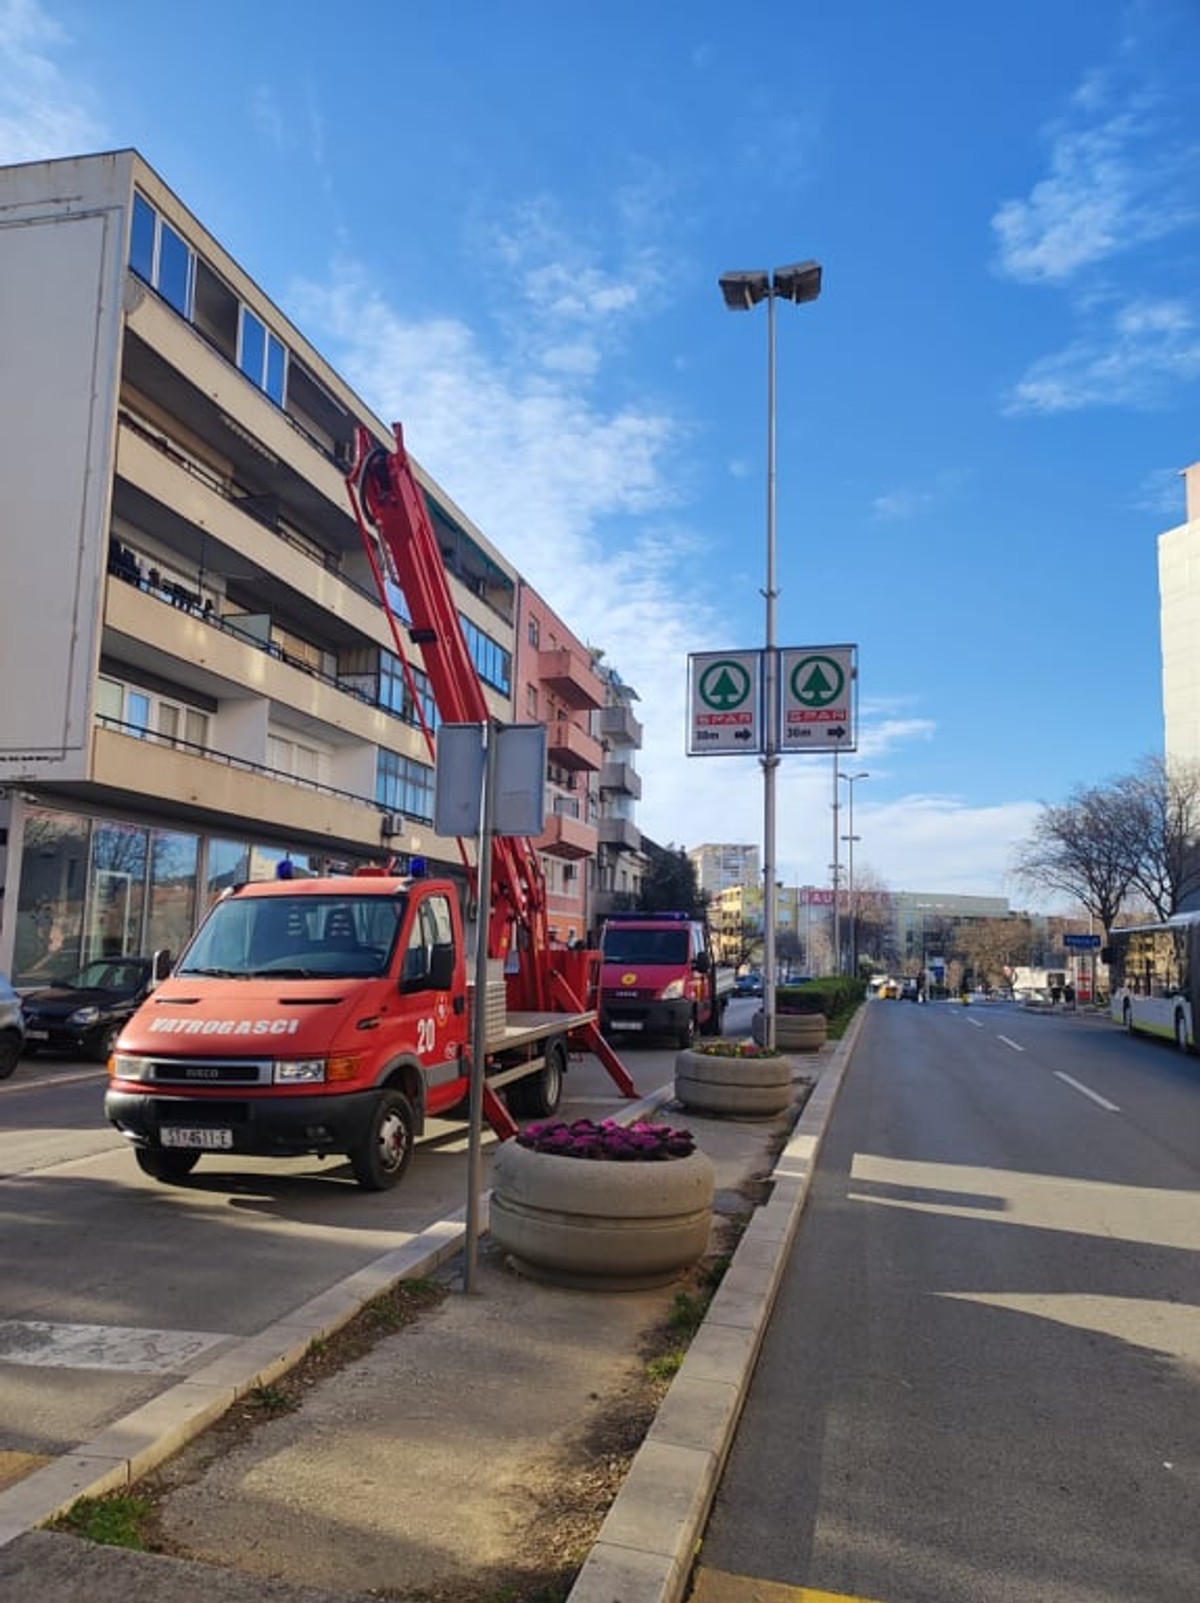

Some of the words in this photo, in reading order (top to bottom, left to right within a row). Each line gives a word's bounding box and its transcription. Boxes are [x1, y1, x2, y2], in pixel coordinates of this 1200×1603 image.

[697, 712, 752, 725] SPAR
[788, 710, 846, 722] SPAR
[150, 1018, 299, 1035] VATROGASCI
[417, 1018, 435, 1054] 20
